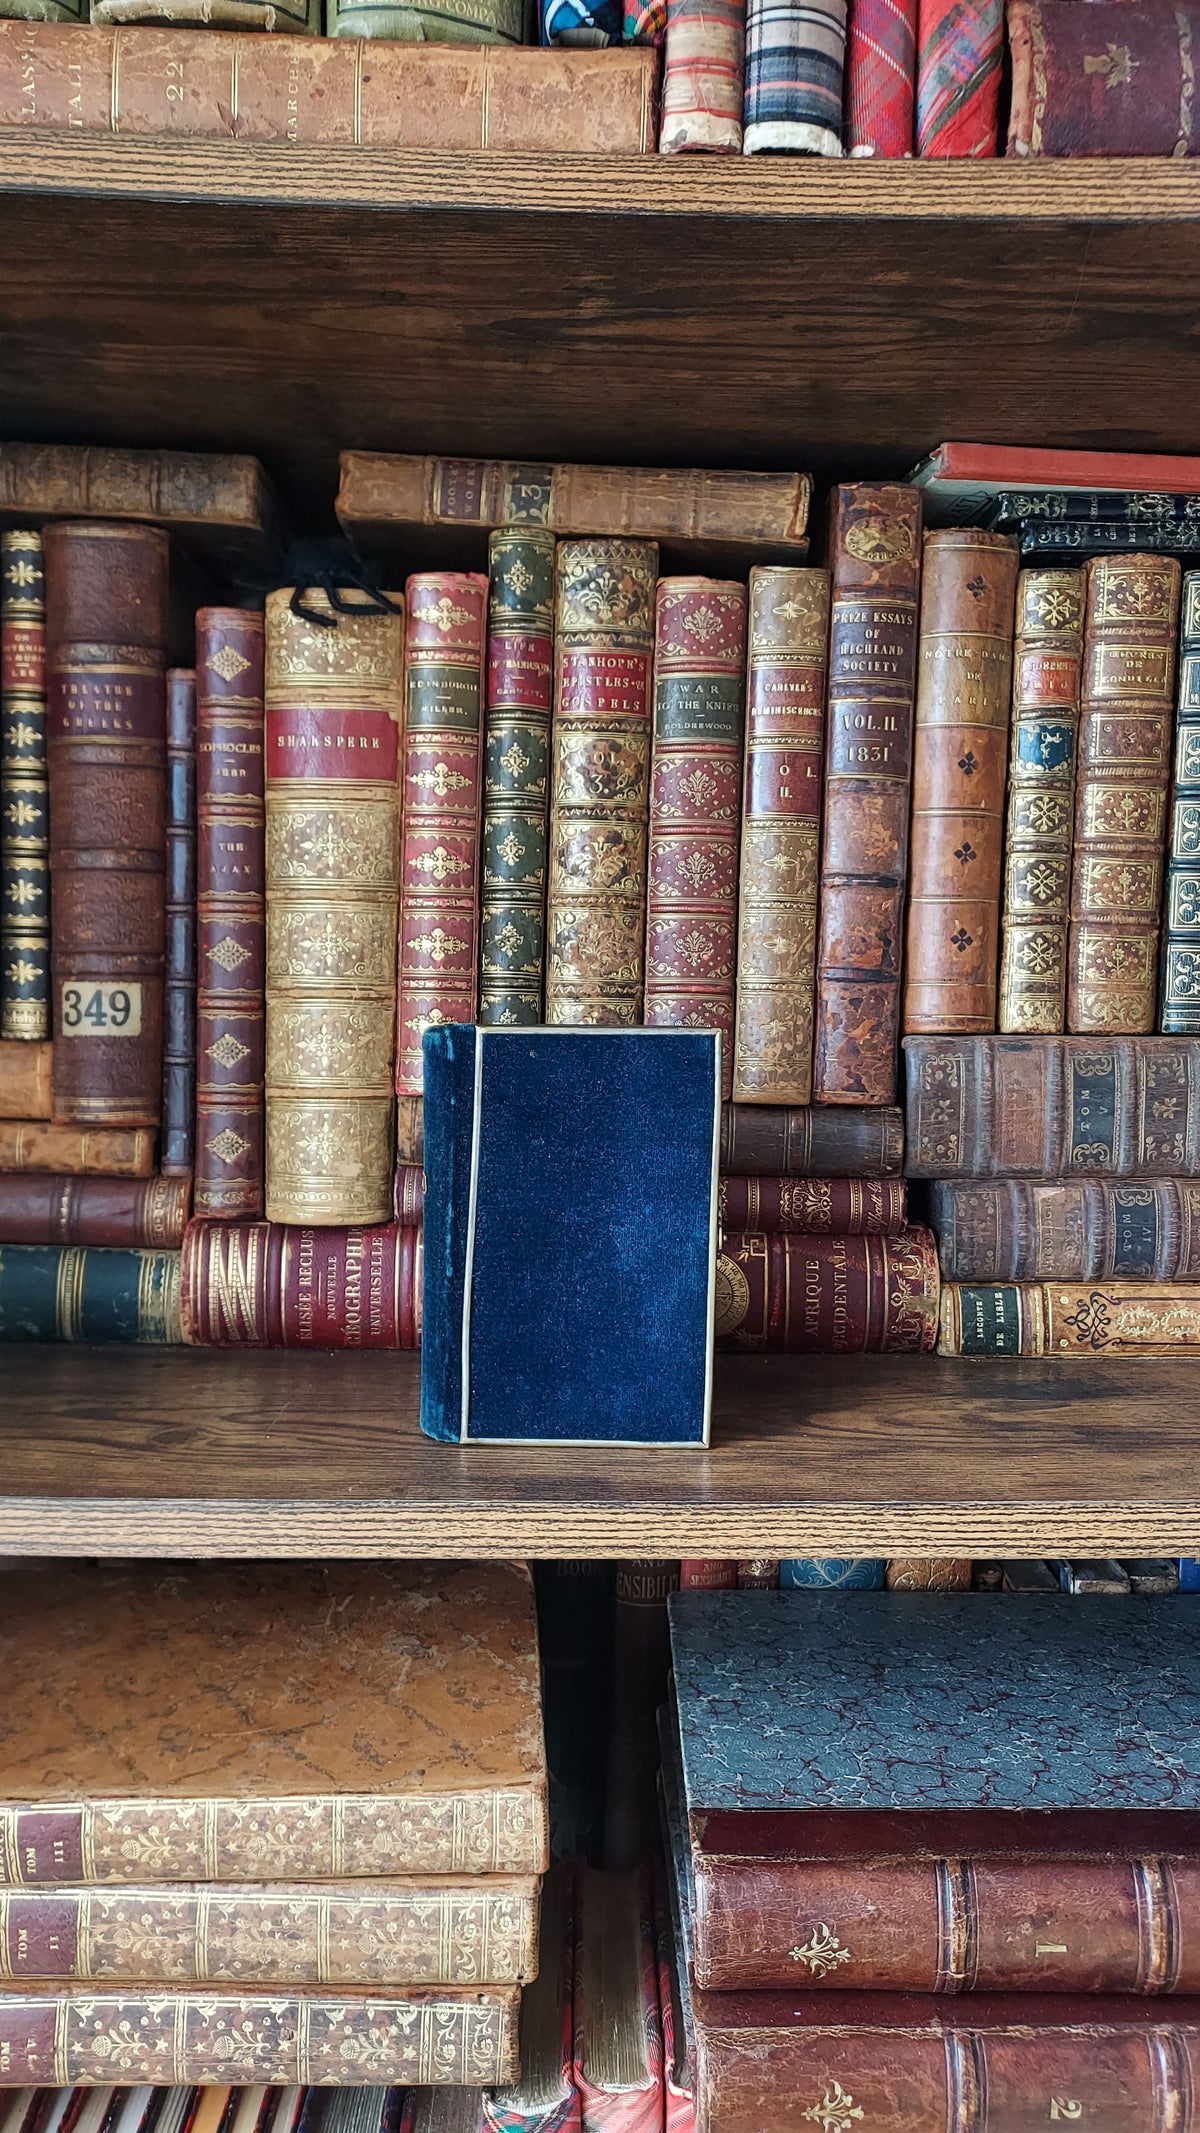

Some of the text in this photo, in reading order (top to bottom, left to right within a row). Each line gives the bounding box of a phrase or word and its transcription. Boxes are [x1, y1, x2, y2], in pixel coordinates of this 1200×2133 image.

[166, 62, 184, 102] 22
[521, 484, 542, 501] 3
[833, 612, 913, 626] PRIZE ESSAYS
[864, 628, 881, 639] OF
[505, 641, 535, 653] LIFE
[840, 644, 904, 656] HIGHLAND
[562, 656, 645, 671] STANHOPE'S
[842, 661, 899, 673] SOCIETY
[1126, 660, 1143, 669] DE
[967, 671, 981, 681] DE
[62, 683, 133, 697] THEATRE
[680, 684, 720, 694] WAR
[764, 680, 813, 693] CARLYLE'S
[94, 701, 122, 712] THE
[562, 697, 641, 711] GOSPELS
[657, 701, 740, 712] TO THE KNIFE
[62, 717, 133, 730] GREEKS
[664, 722, 732, 731] BOLDREWOOD
[277, 734, 380, 749] SHAKSPERE
[847, 746, 889, 763] 1831
[218, 842, 244, 852] THE
[210, 864, 251, 874] AJAX
[64, 989, 131, 1027] 349
[1080, 1089, 1090, 1132] TOM
[1122, 1213, 1132, 1252] TOM
[1142, 1226, 1152, 1242] IV
[299, 1230, 315, 1287] RECLUS
[326, 1256, 337, 1320] NOUVELLE
[370, 1237, 383, 1336] UNIVERSELLE
[805, 1260, 823, 1337] AFRIQUE
[976, 1301, 984, 1338] LECONTE
[994, 1292, 1005, 1347] DE LISLE
[703, 1563, 724, 1573] AND
[53, 1840, 64, 1864] III
[26, 1847, 37, 1874] TOM
[18, 1929, 28, 1960] TOM
[49, 1936, 60, 1951] II
[0, 2041, 11, 2073] TOM
[1050, 2096, 1083, 2121] 2
